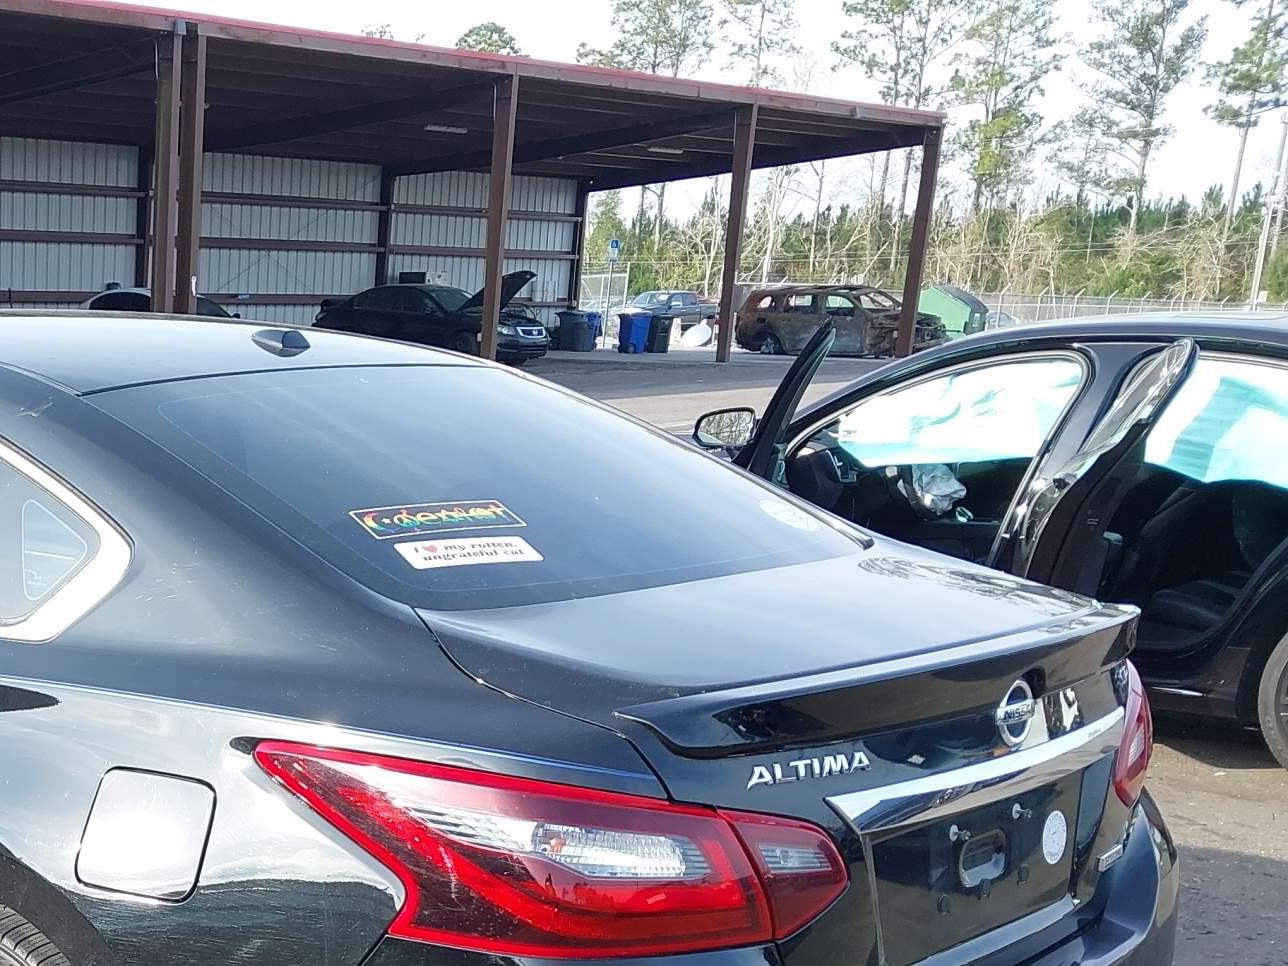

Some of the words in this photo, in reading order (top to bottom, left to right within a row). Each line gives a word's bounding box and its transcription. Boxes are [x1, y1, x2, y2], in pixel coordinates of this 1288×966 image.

[422, 549, 498, 561] ungrateful
[1003, 703, 1033, 720] NISSA
[746, 751, 872, 790] ALTIMA
